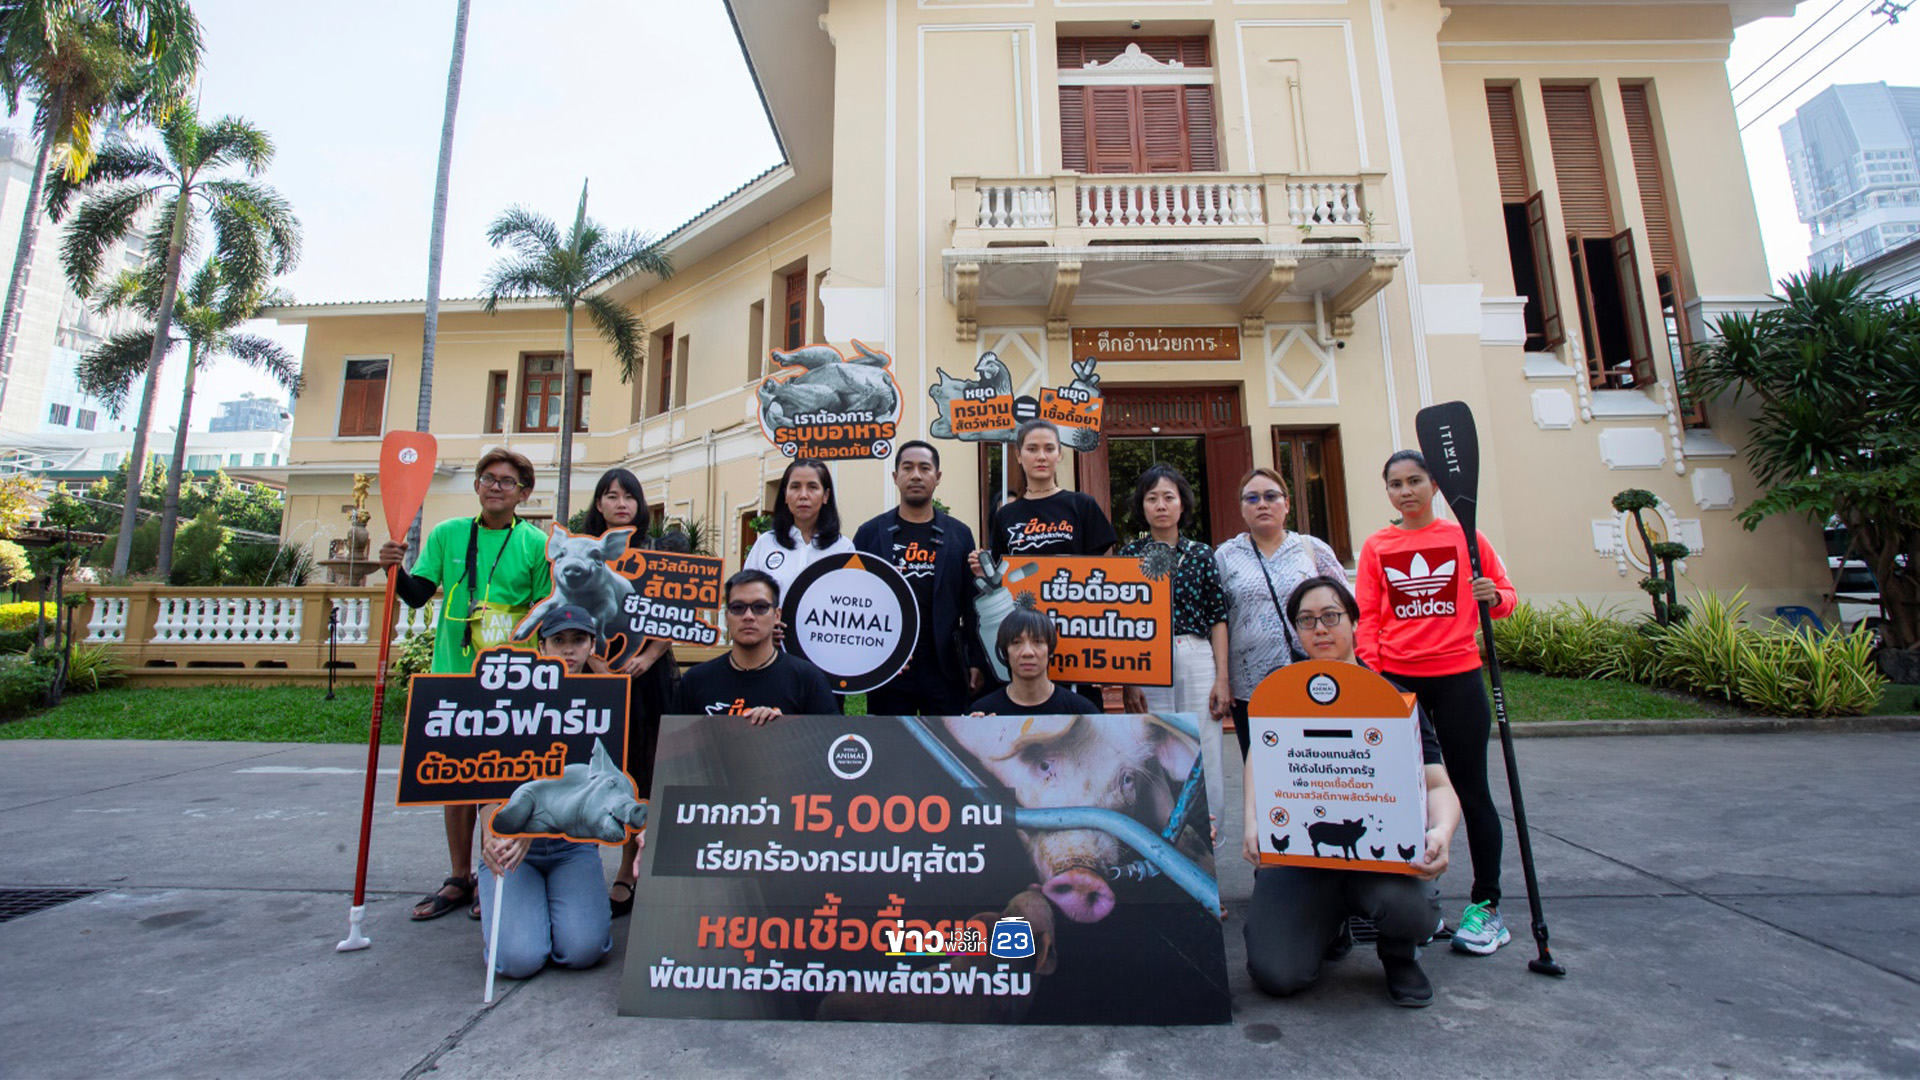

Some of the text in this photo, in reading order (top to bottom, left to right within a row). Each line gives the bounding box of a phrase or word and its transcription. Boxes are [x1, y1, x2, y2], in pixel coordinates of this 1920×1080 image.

[1098, 331, 1215, 352] ตึกอำนวยการ
[965, 388, 995, 401] หยุด
[1059, 388, 1089, 403] หยุด
[795, 409, 873, 424] เราต้องการ
[955, 402, 1009, 418] ทรมาน
[1043, 404, 1099, 426] เชื้อดื้อยา
[776, 422, 895, 443] ระบบอาหาร
[955, 415, 1011, 431] สัตว์ฟาร์ม
[798, 442, 871, 459] ที่ปลอดภัย
[1439, 425, 1461, 472] ITIWIT
[648, 557, 719, 577] สวัสดิภาพ
[644, 574, 717, 603] สัตว์ดี
[1042, 570, 1150, 602] เชื้อดื้อยา
[624, 594, 695, 622] ชีวิตคน
[830, 595, 873, 608] WORLD
[1395, 598, 1455, 618] adidas
[630, 615, 716, 644] ปลอดภัย
[804, 608, 893, 633] ANIMAL
[1049, 610, 1154, 638] ่าคนไทย
[810, 631, 885, 647] PROTECTION
[480, 653, 560, 690] ชีวิต
[1049, 649, 1152, 673] ทุก 15 นาที
[425, 698, 611, 737] สัตว์ฟาร์ม
[418, 743, 566, 783] ต้องดีกว่านี้
[1287, 747, 1371, 760] ส่งเสียงแทนสัตว์
[1288, 763, 1375, 777] ให้ดังไปถึงภาครัฐ
[1293, 777, 1374, 789] เพื่อ หยุดเชื้อดื้อยา
[1274, 789, 1397, 803] พัฒนาสวัสดิภาพสัตว์ฟาร์ม
[676, 794, 1002, 838] มากกว่า 15,000 คน
[696, 840, 985, 882] เรียกร้องกรมปศุสัตว์
[649, 957, 1031, 996] พัฒนาสวัสดิภาพสัตว์ฟาร์ม
